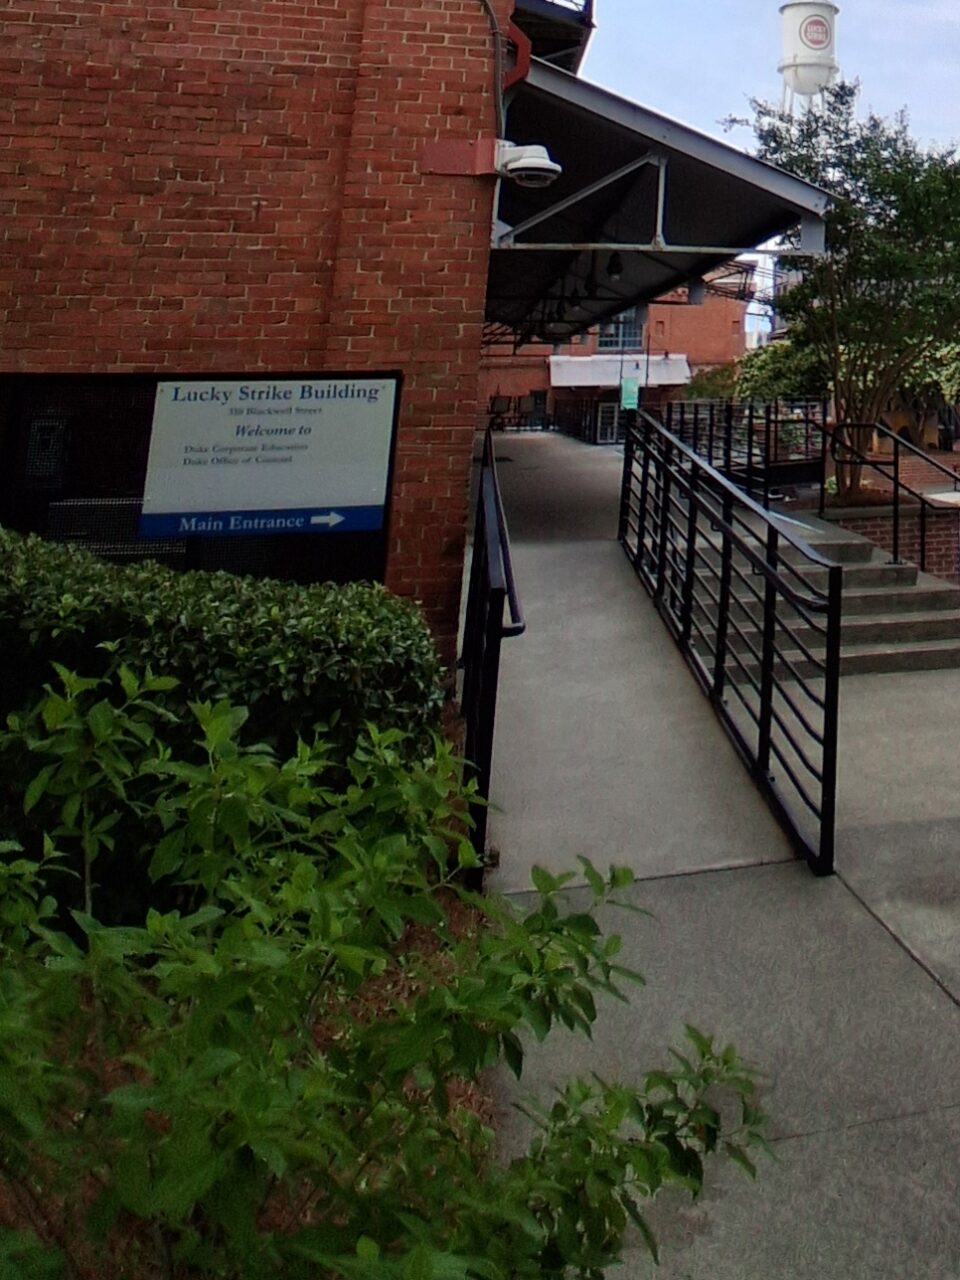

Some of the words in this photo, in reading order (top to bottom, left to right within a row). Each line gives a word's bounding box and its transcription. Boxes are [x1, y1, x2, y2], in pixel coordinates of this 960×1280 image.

[172, 386, 232, 405] Lucky
[239, 384, 292, 401] Strike
[300, 384, 380, 402] Building
[295, 406, 322, 415] Street
[235, 424, 294, 437] Welcome
[298, 424, 312, 435] to
[183, 457, 208, 465] Duke
[178, 517, 223, 532] Main
[229, 514, 304, 530] Entrance
